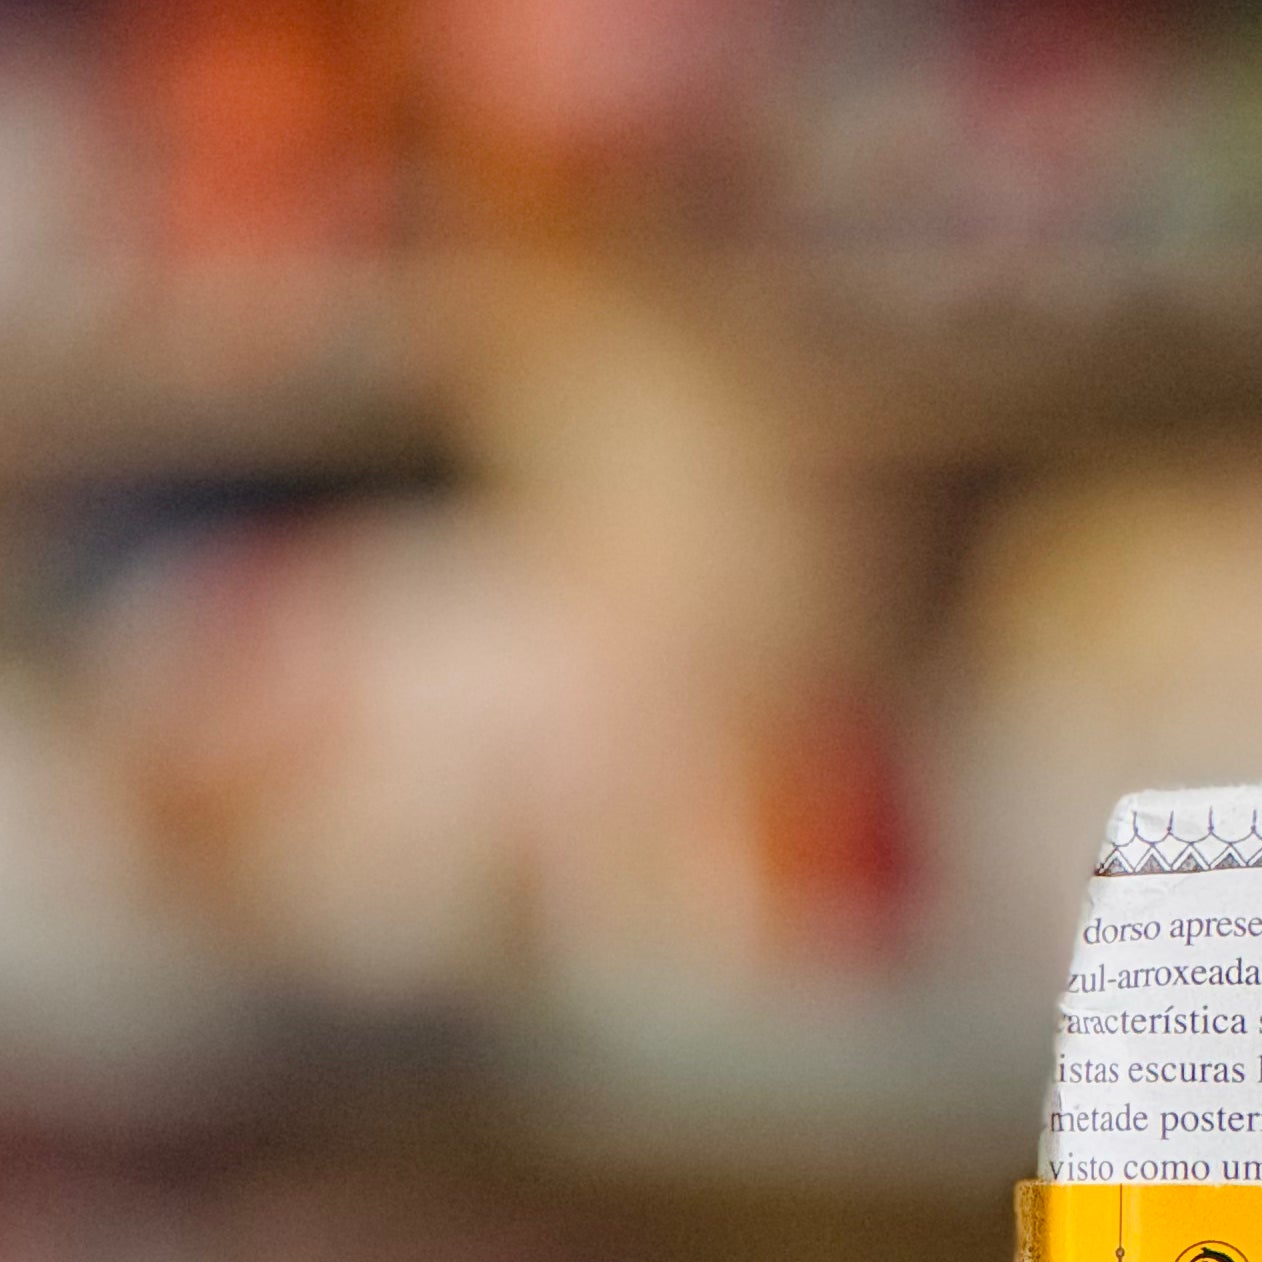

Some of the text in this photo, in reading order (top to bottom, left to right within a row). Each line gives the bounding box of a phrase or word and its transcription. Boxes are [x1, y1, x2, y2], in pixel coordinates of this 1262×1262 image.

[1082, 917, 1162, 946] dorso
[1059, 1052, 1120, 1084] istas
[1127, 1061, 1246, 1084] escuras
[1050, 1102, 1150, 1133] metade
[1046, 1145, 1114, 1182] visto
[1123, 1159, 1211, 1182] como
